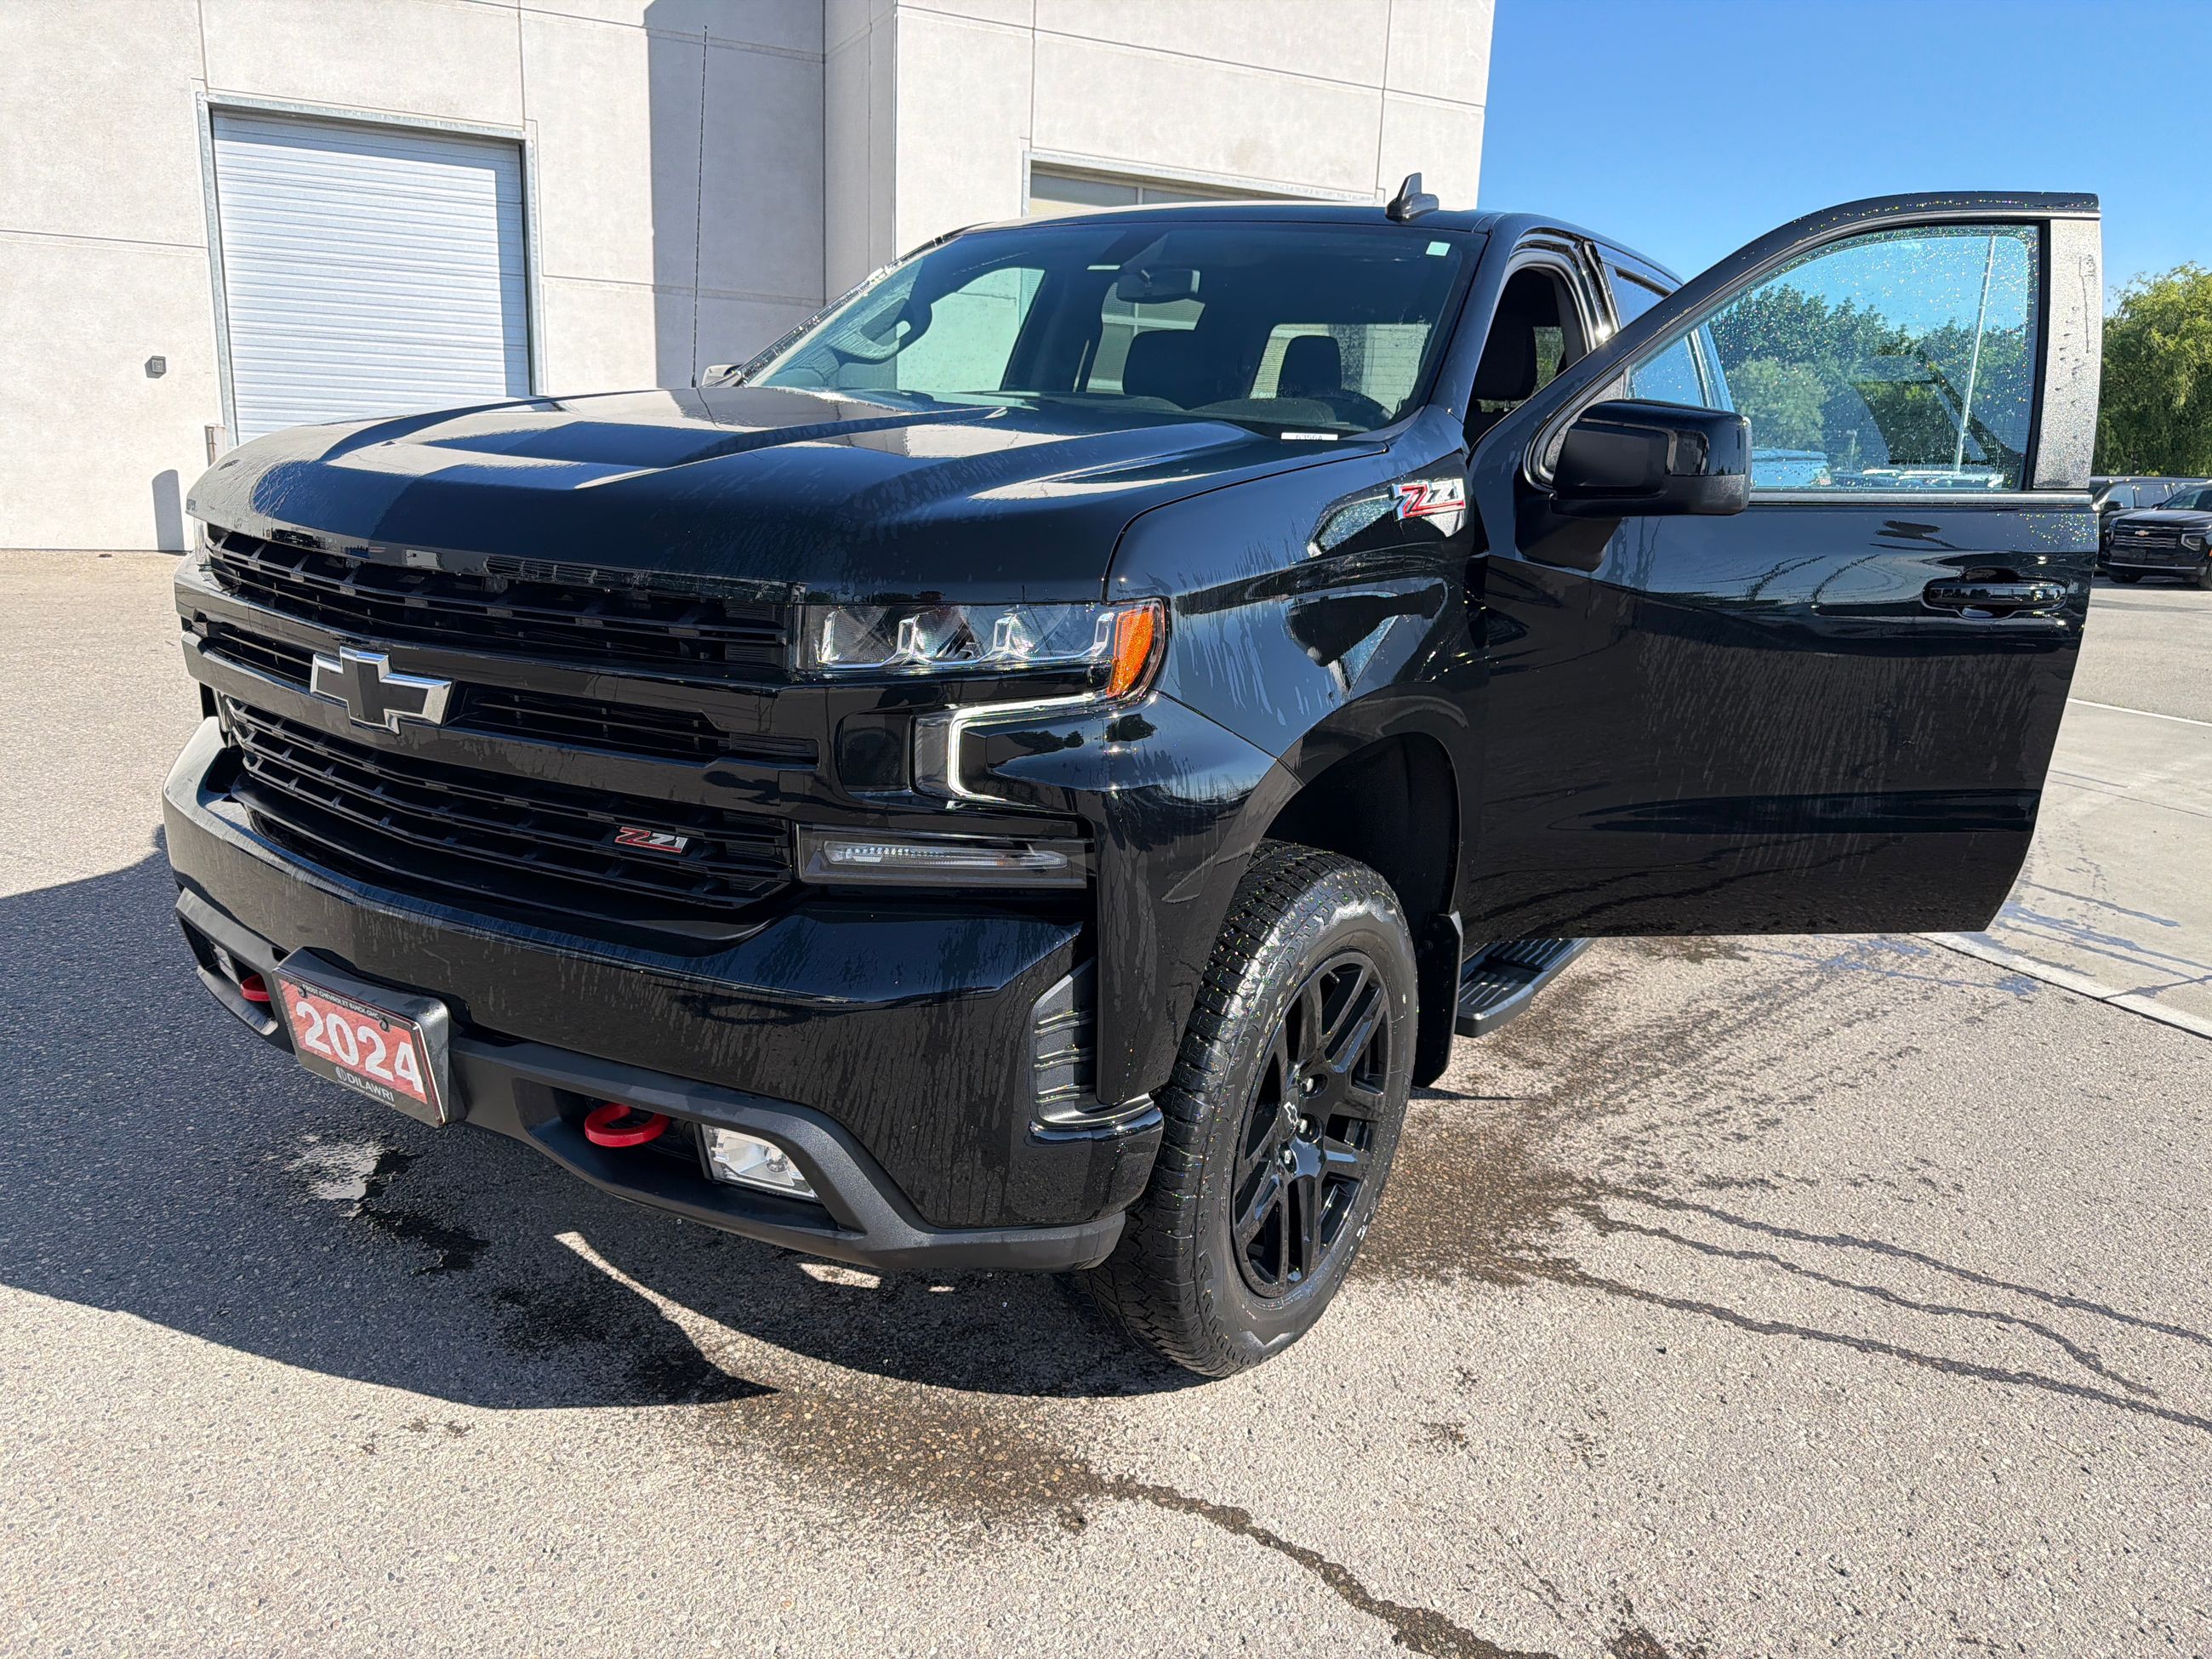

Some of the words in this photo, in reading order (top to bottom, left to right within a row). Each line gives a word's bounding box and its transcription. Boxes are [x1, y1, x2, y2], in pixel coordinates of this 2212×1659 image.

[1393, 478, 1466, 521] Z71
[614, 826, 688, 853] Z71
[319, 990, 349, 1007] CHEVROLET
[296, 1001, 425, 1094] 2024
[346, 1072, 395, 1103] DILAWRI
